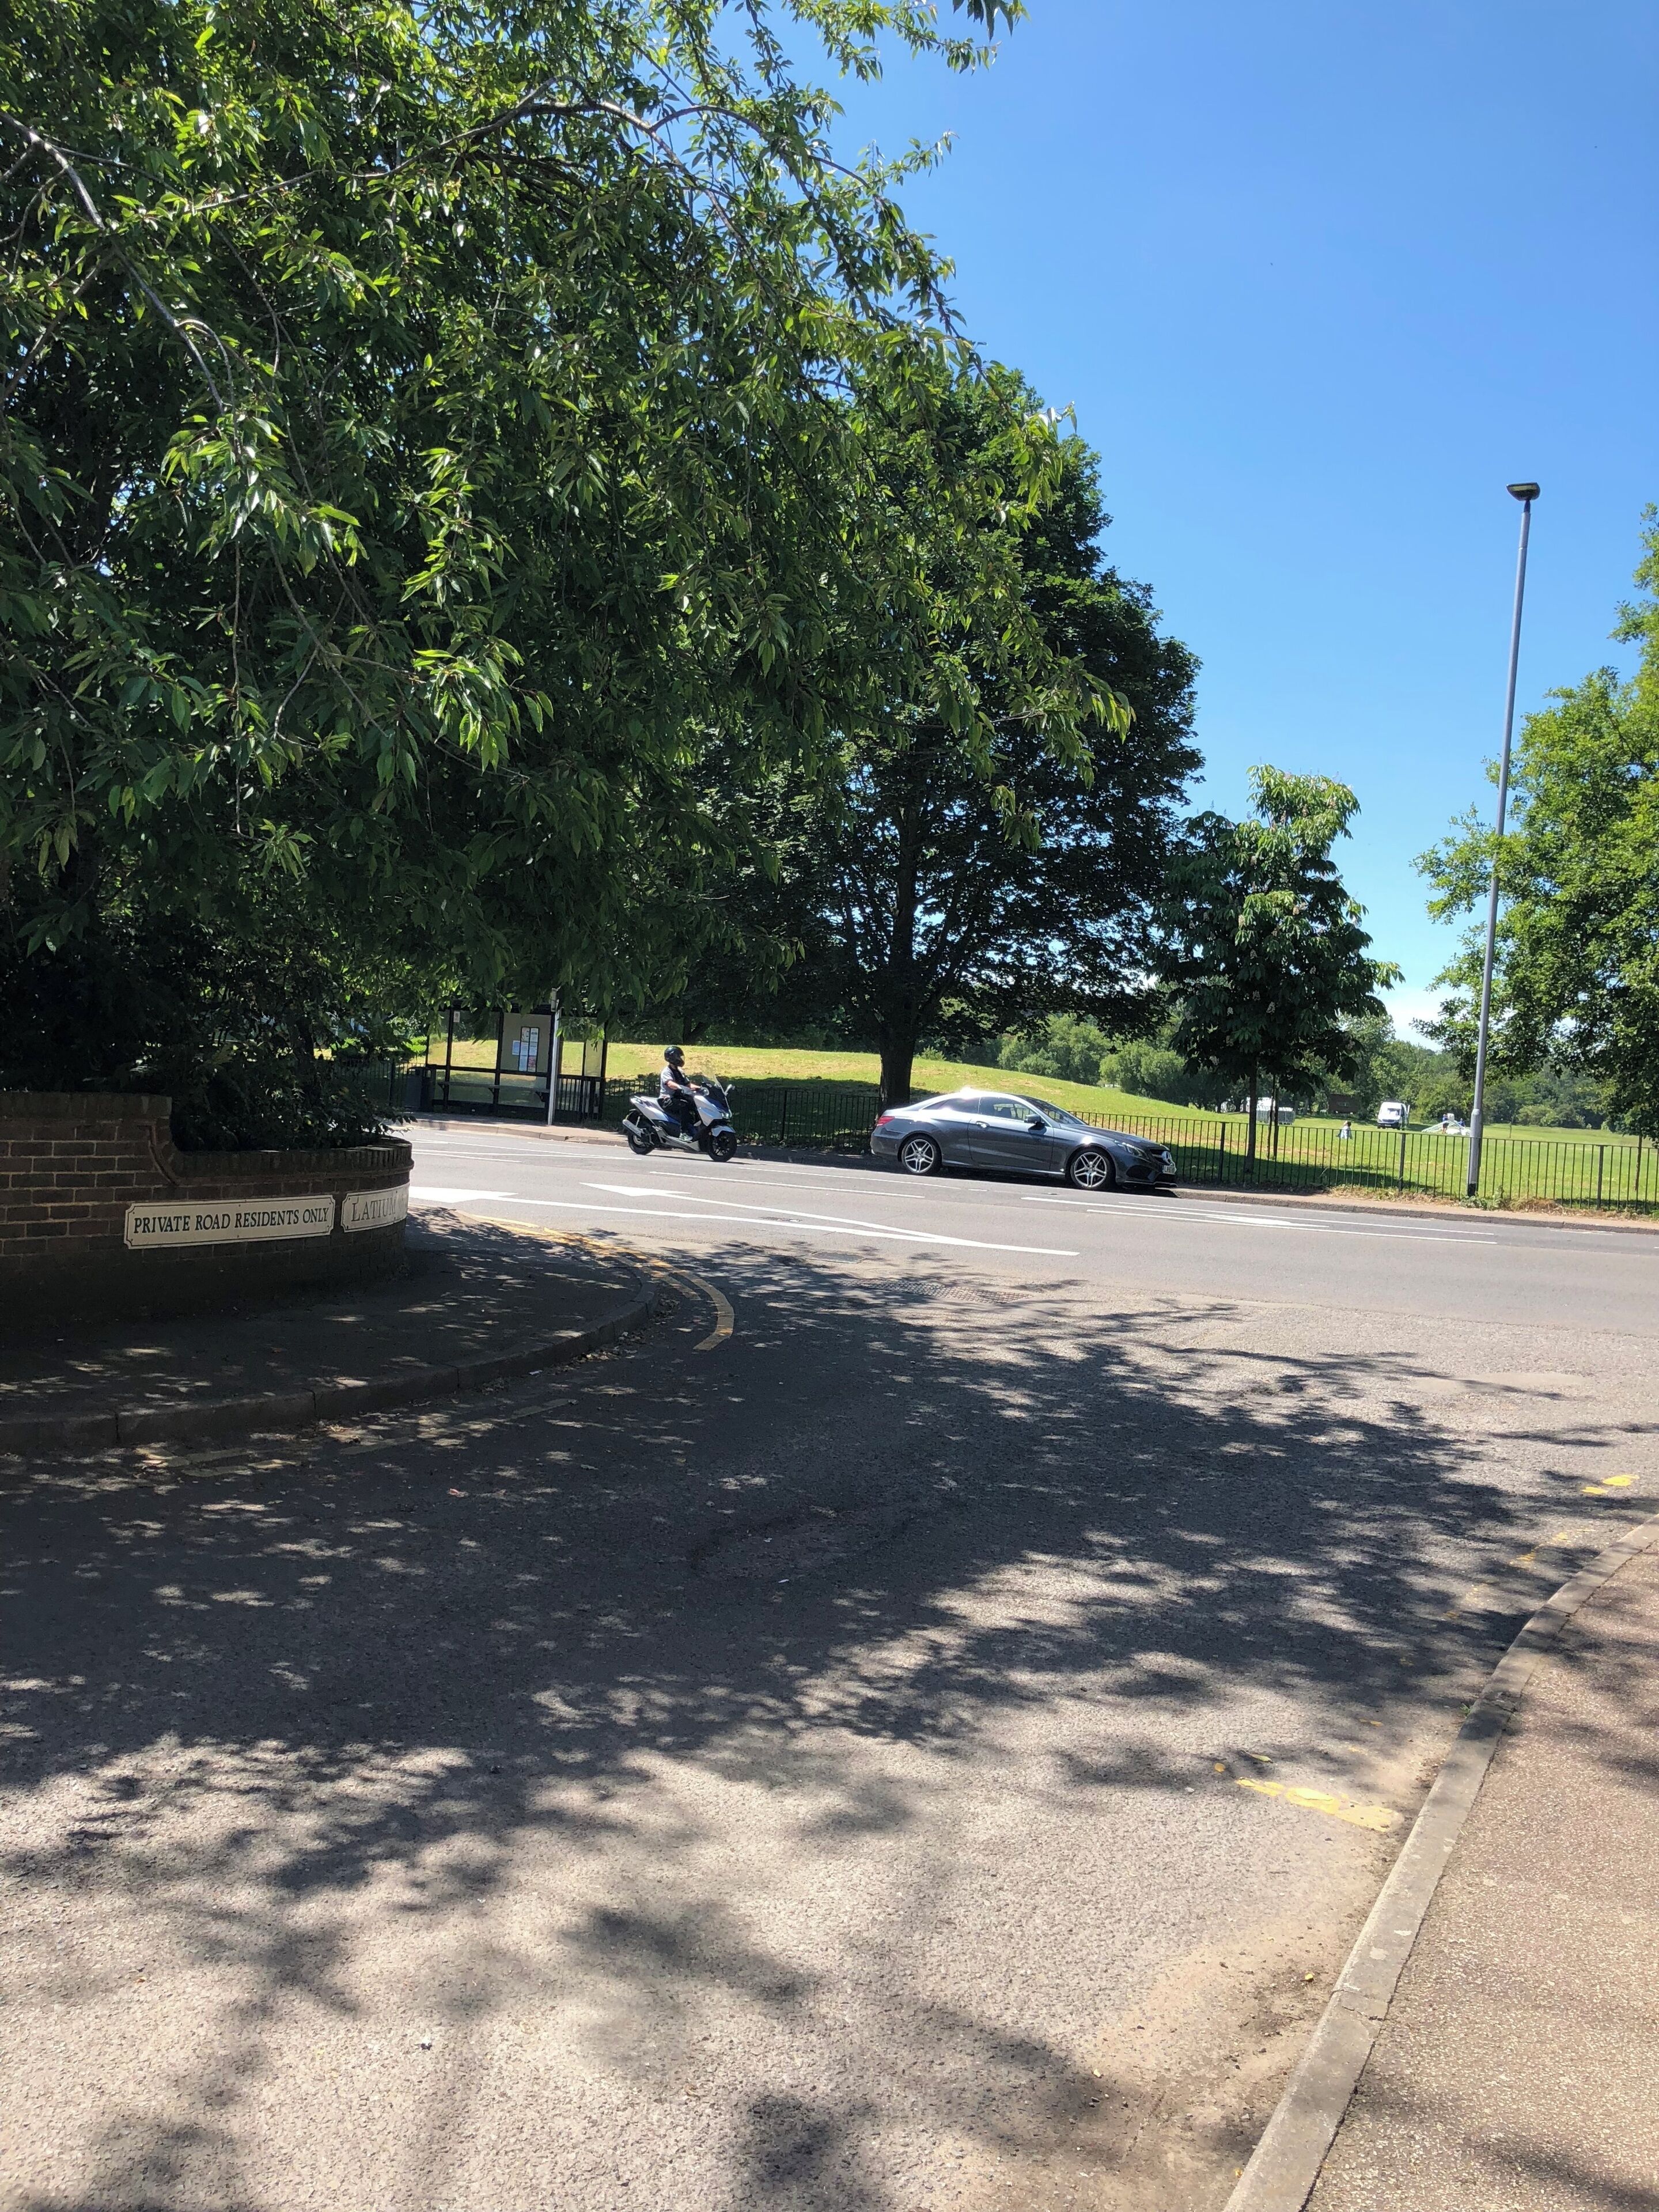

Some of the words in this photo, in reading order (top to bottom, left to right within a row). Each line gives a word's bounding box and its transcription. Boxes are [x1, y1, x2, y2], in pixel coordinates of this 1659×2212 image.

[134, 1215, 191, 1233] PRIVATE
[195, 1213, 230, 1230] ROAD
[234, 1210, 299, 1228] RESIDENTS
[302, 1207, 329, 1223] ONLY
[351, 1197, 396, 1221] LATIUM
